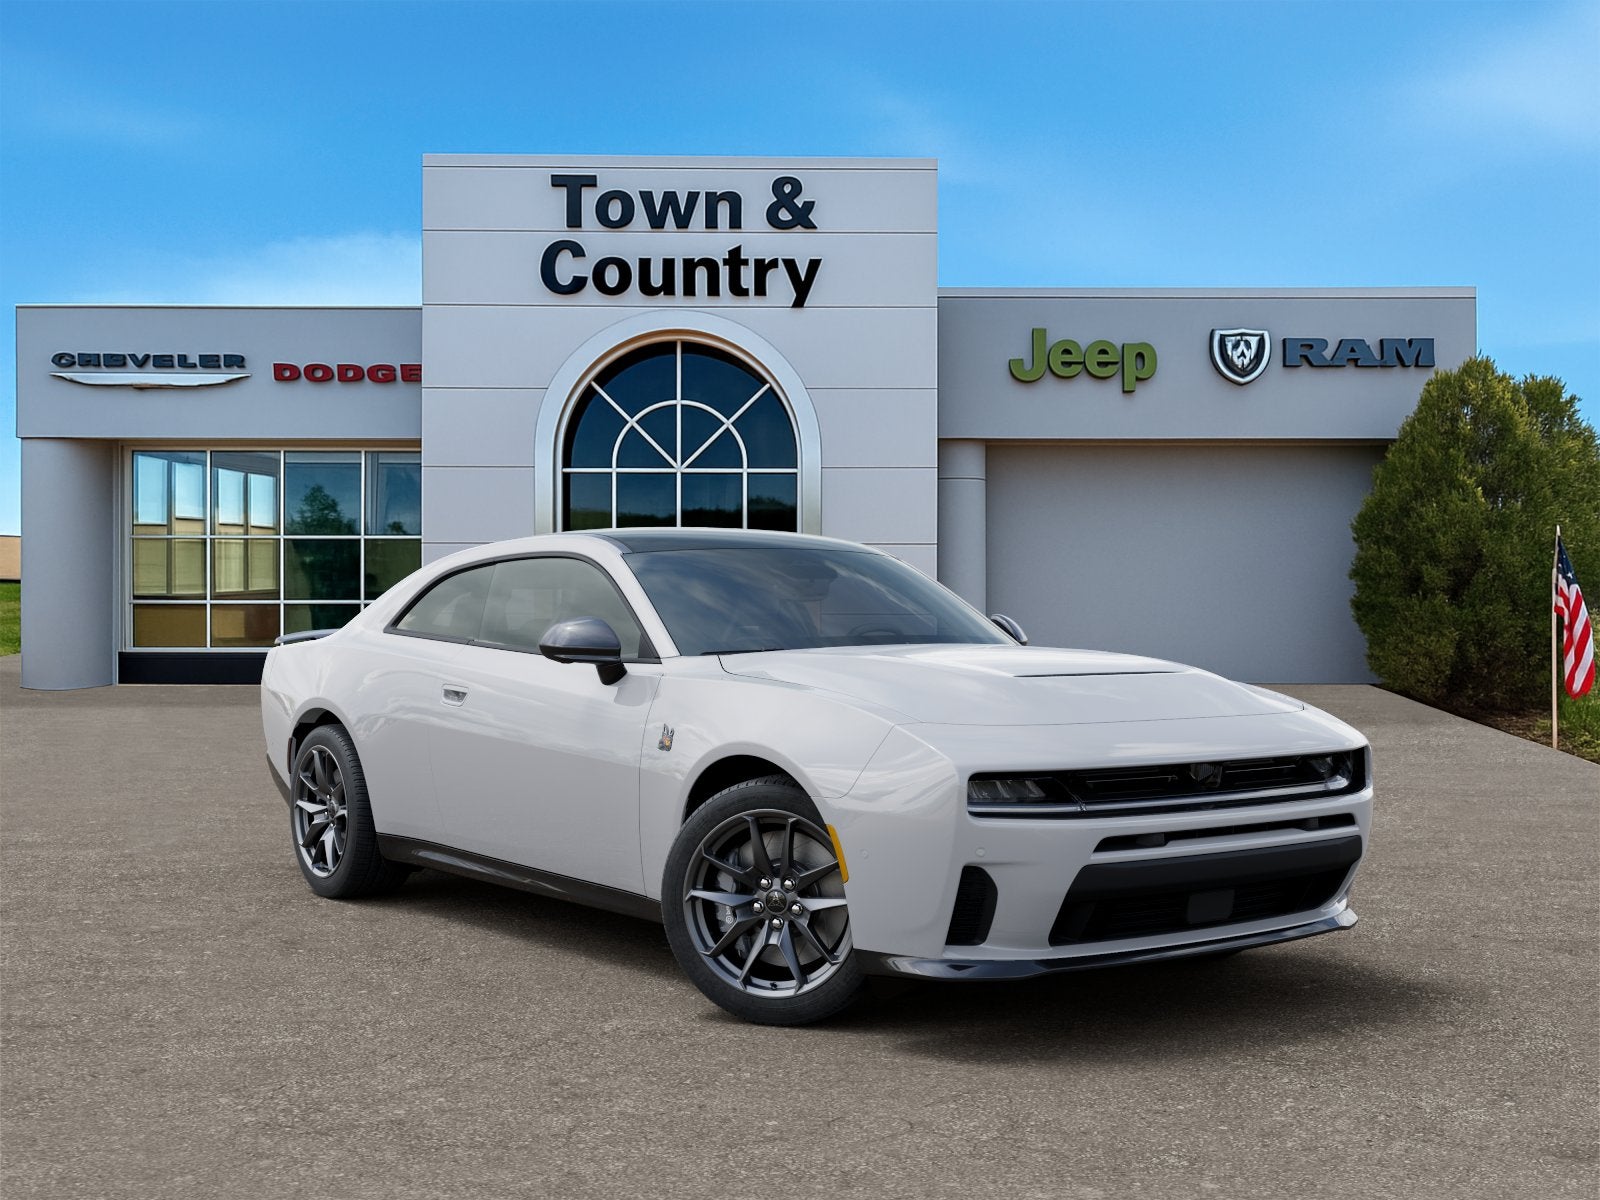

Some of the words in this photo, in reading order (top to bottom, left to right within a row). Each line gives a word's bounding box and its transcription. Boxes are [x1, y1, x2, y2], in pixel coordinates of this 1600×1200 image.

[551, 174, 742, 229] Town
[766, 176, 818, 229] &
[540, 240, 822, 308] Country
[273, 363, 422, 383] DODGE
[1009, 328, 1157, 393] Jeep
[1282, 338, 1435, 367] RAM
